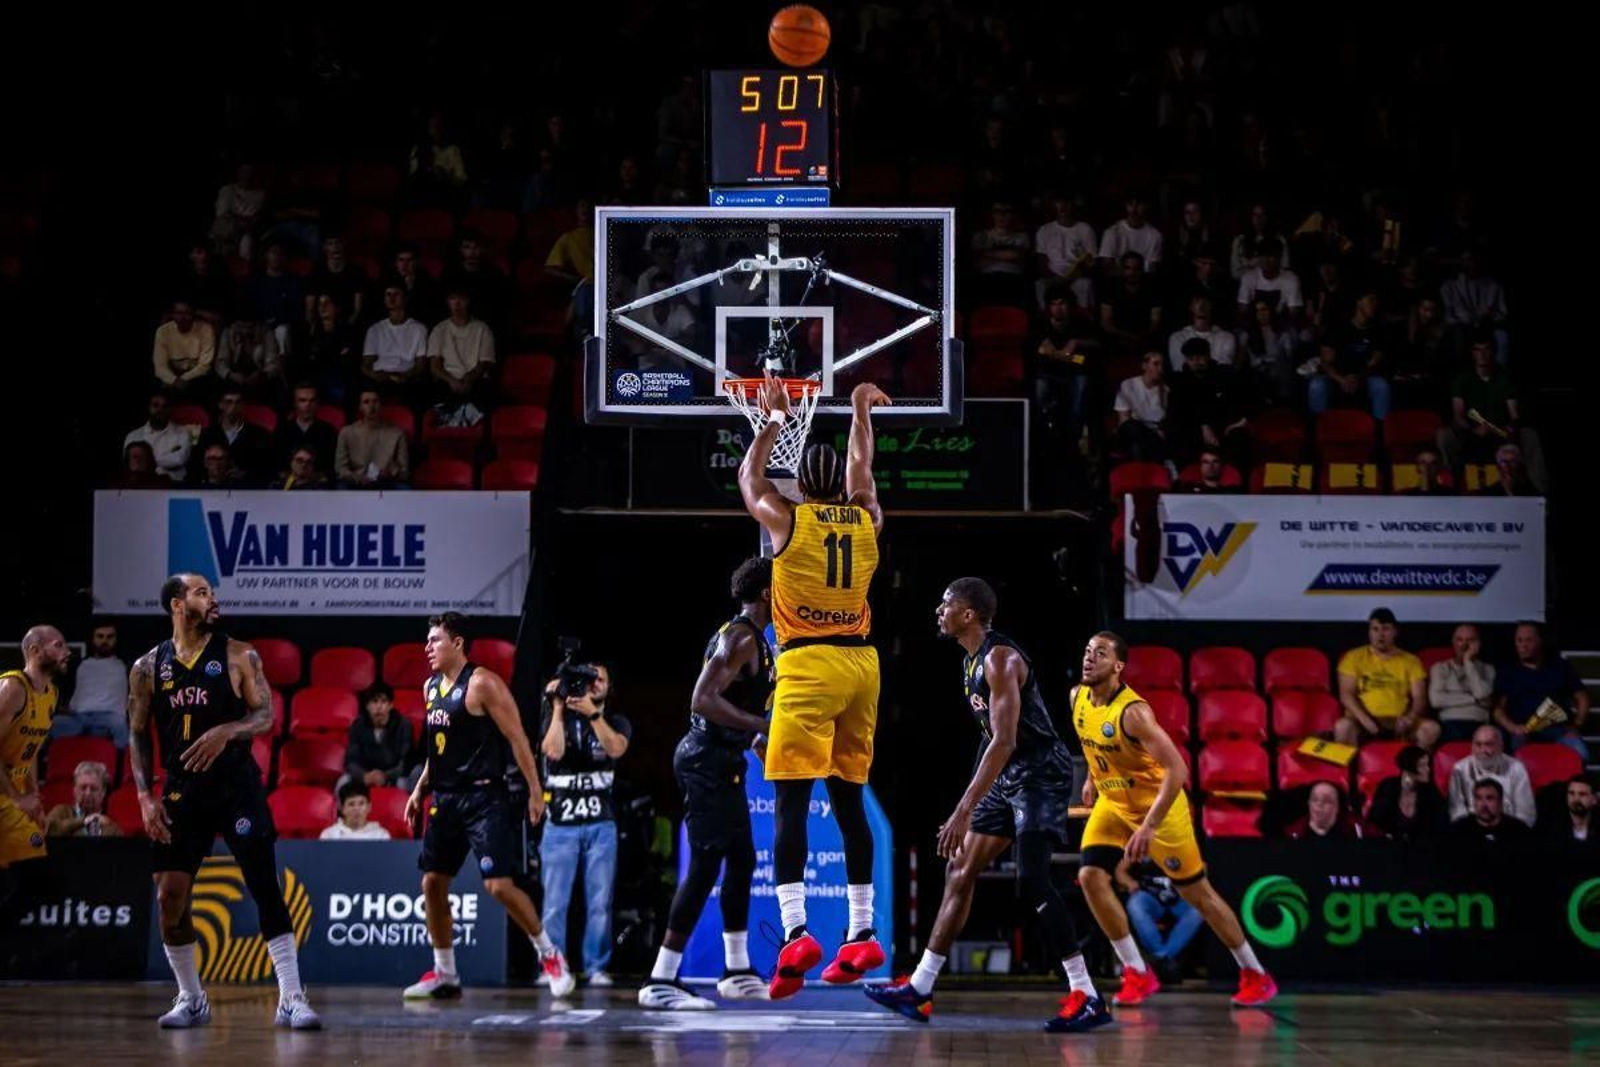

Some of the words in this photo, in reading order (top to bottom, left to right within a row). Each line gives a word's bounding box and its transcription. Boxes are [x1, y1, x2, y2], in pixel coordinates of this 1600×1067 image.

[741, 76, 761, 112] 5
[778, 75, 824, 110] 07
[756, 121, 808, 175] 12
[1280, 520, 1302, 532] DE
[1308, 520, 1359, 532] WITTE
[1380, 521, 1497, 534] VANDECAVEYE
[1502, 522, 1525, 534] BV
[207, 510, 289, 577] VAN
[303, 523, 426, 567] HUELE
[823, 532, 853, 589] 11
[236, 577, 260, 589] UW
[262, 577, 319, 589] PARTNER
[323, 577, 359, 589] VOOR
[362, 577, 380, 589] DE
[383, 576, 426, 589] BOUW
[1323, 568, 1488, 586] www.dewittevdc.be
[169, 686, 208, 708] MSK
[183, 713, 192, 741] 1
[427, 708, 450, 726] MSK
[435, 731, 446, 756] 9
[561, 796, 602, 822] 249
[1328, 874, 1361, 887] THE
[1322, 890, 1496, 946] green
[327, 922, 477, 947] CONSTRT.
